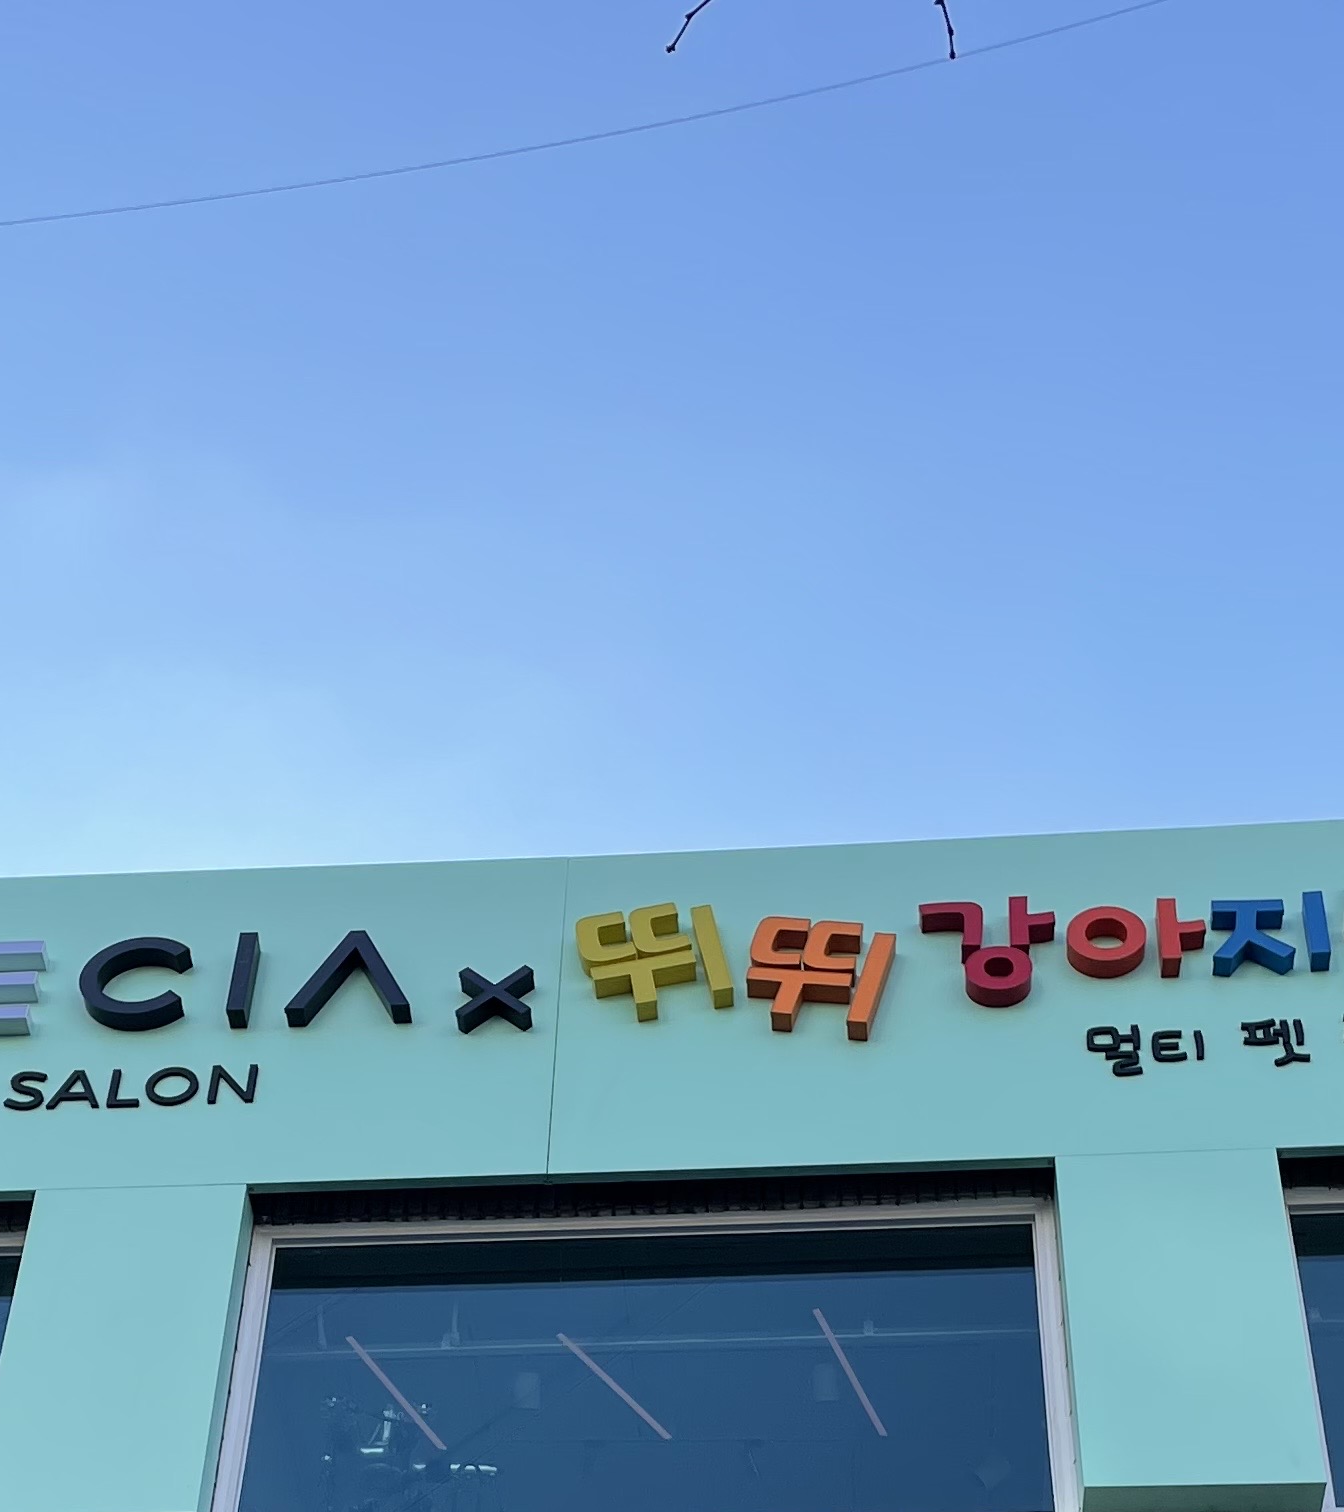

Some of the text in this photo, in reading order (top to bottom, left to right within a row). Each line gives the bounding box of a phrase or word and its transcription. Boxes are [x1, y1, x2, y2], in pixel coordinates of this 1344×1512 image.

[1086, 1024, 1205, 1077] 멀티
[1240, 1017, 1311, 1067] 펫
[2, 1063, 261, 1112] SALON
